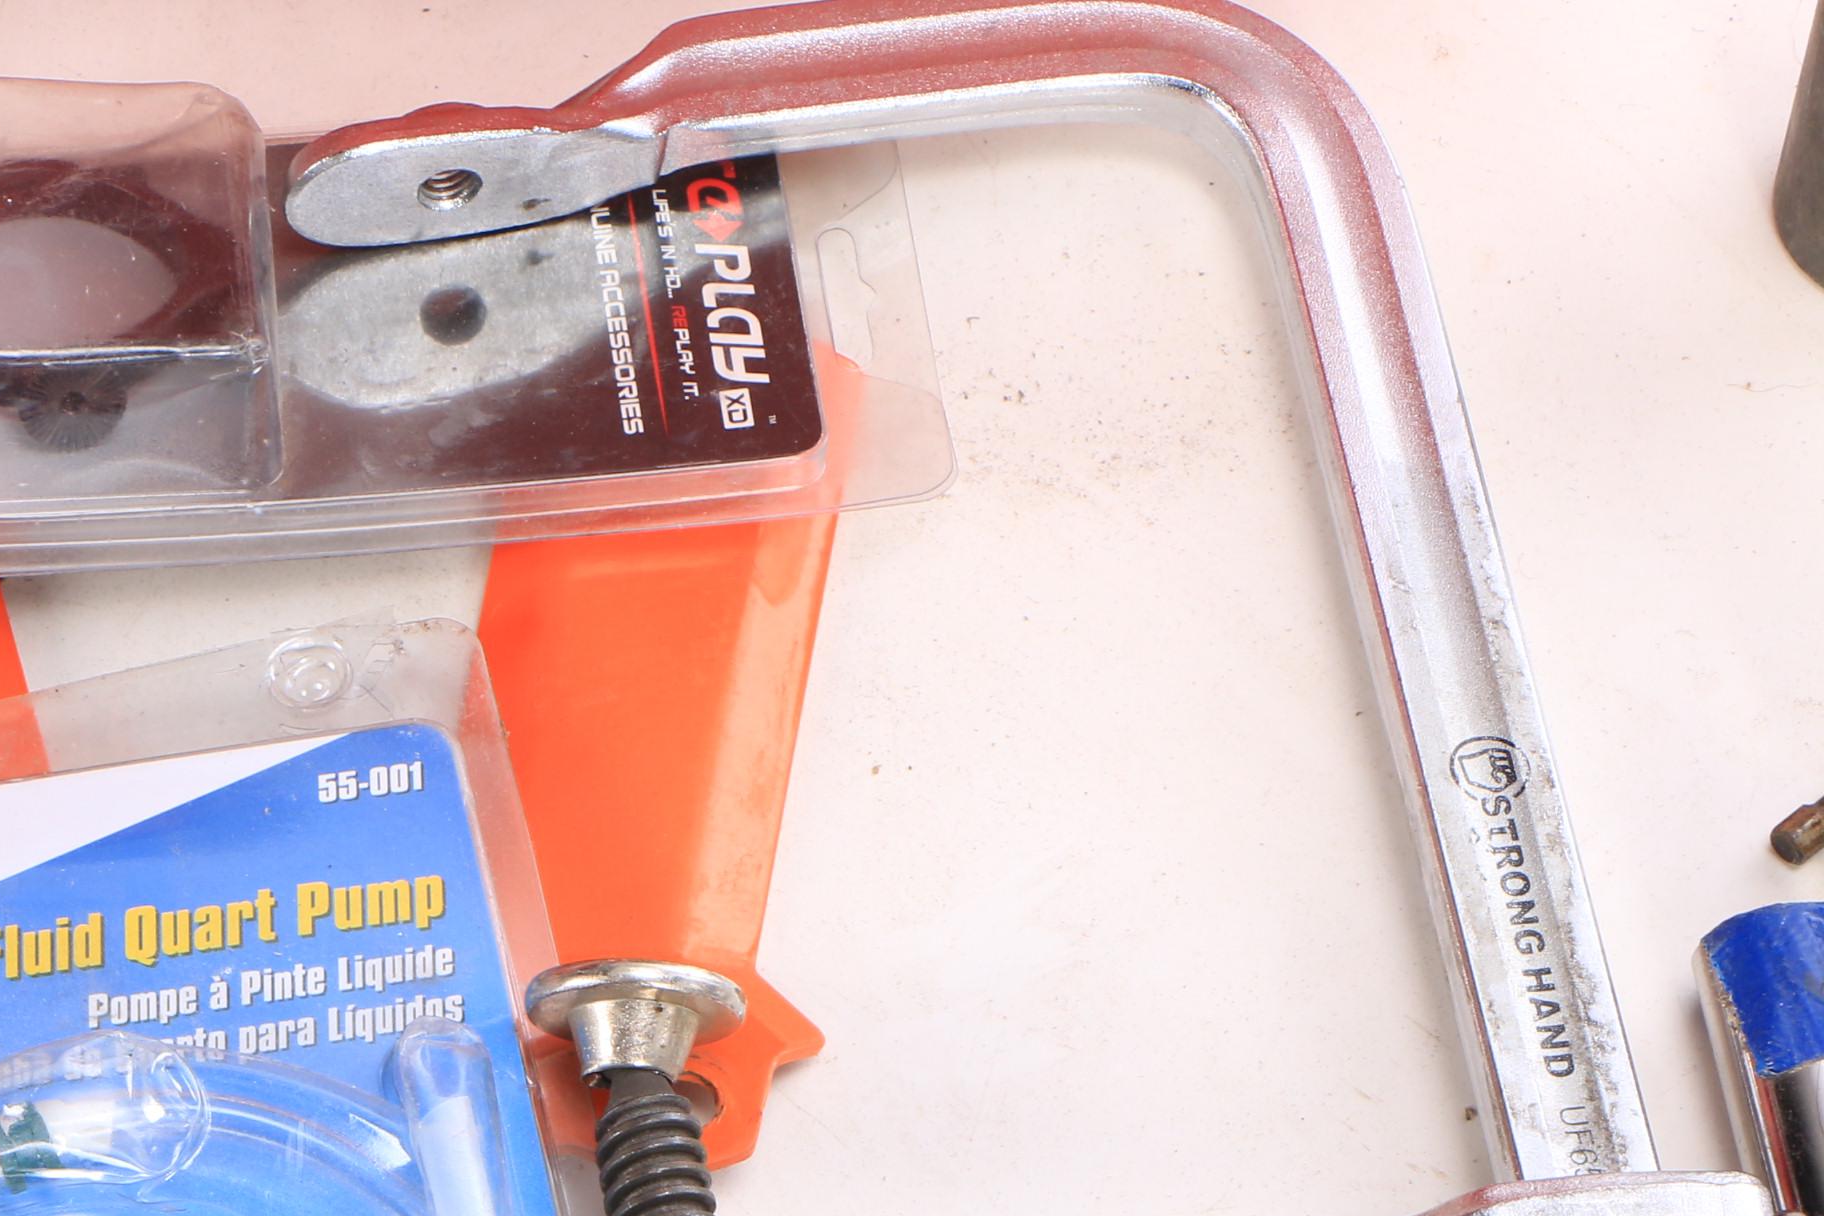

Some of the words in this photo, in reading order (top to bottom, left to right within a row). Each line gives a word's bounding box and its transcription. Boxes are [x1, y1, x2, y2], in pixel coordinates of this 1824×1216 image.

[661, 245, 676, 260] IN
[600, 270, 645, 435] ACCESSORIES
[317, 761, 425, 804] 55-001
[124, 888, 278, 968] Quart
[297, 873, 446, 937] Pump
[1480, 795, 1545, 955] STRONG
[1521, 966, 1575, 1078] HAND
[88, 983, 199, 1030] Pompe
[209, 975, 230, 1011] à
[240, 962, 327, 1007] Pinte
[337, 943, 456, 992] Liquide
[239, 1013, 316, 1053] para
